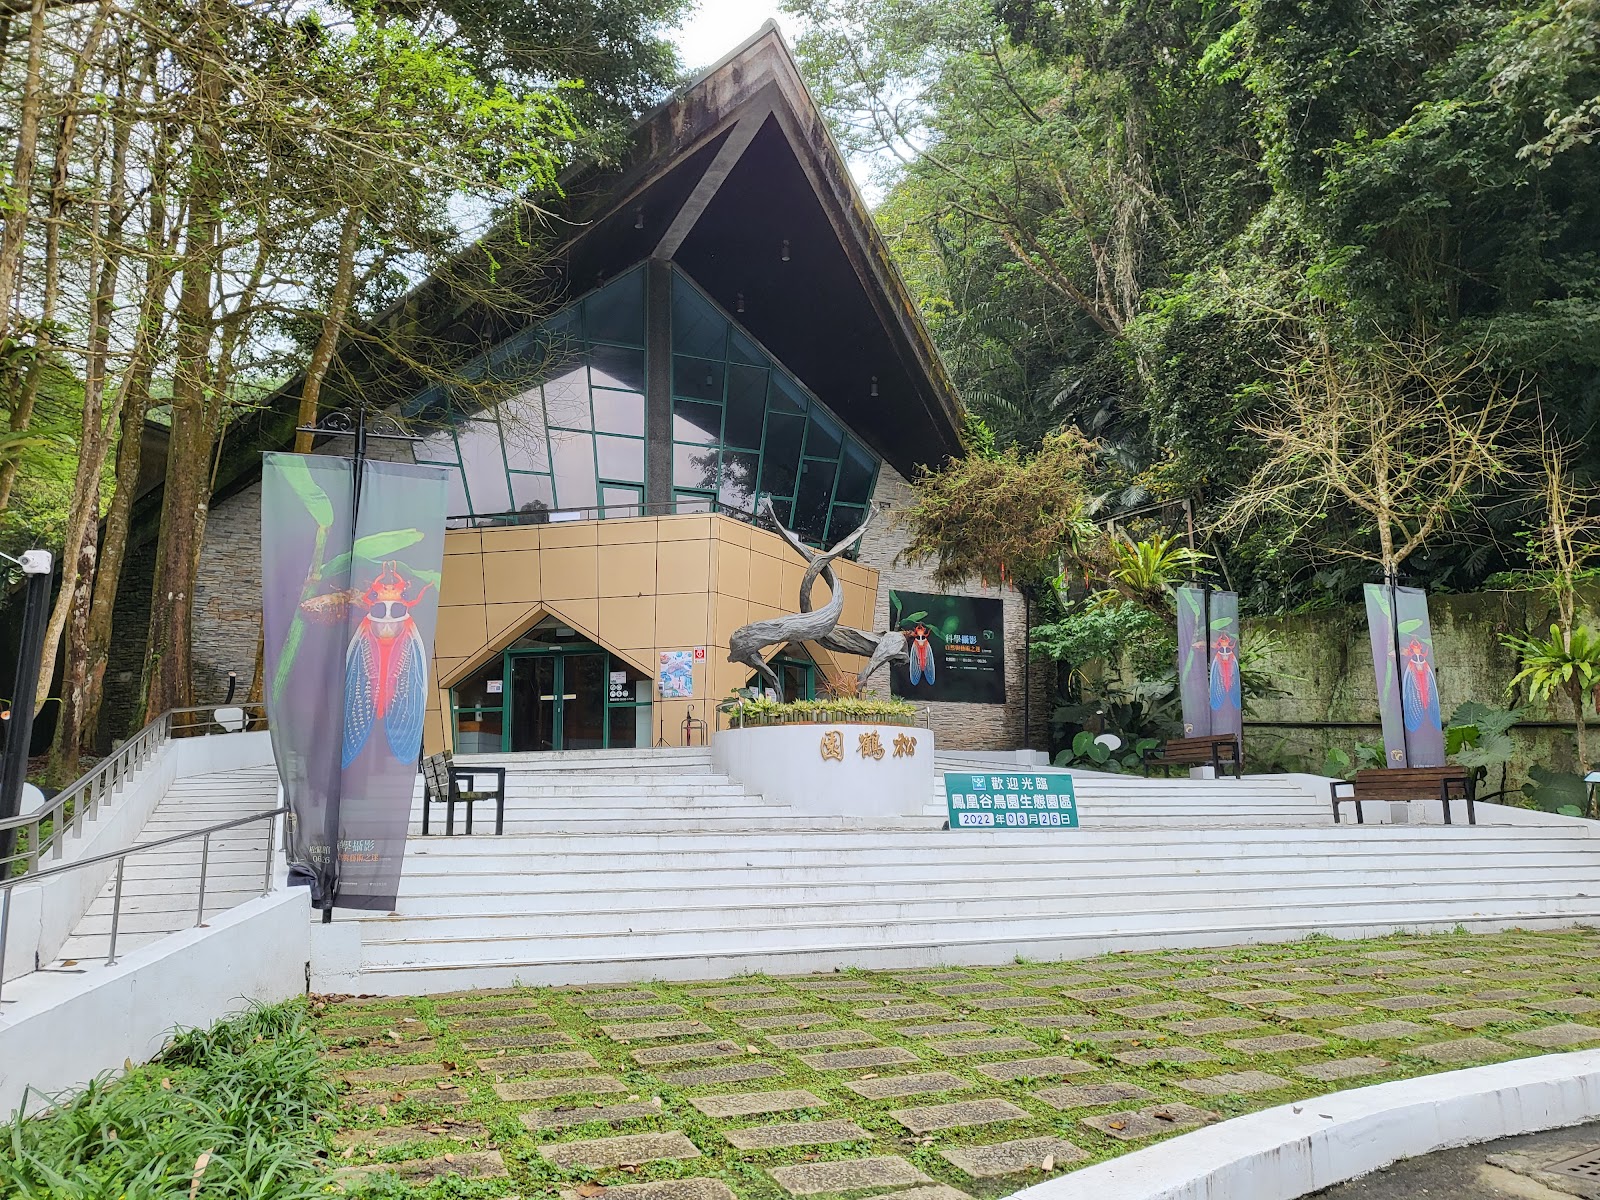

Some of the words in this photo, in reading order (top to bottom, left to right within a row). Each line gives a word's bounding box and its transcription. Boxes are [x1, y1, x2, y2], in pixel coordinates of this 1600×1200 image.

[990, 776, 1049, 790] 歡迎光臨
[952, 793, 1073, 809] 鳳凰谷鳥園生態園區
